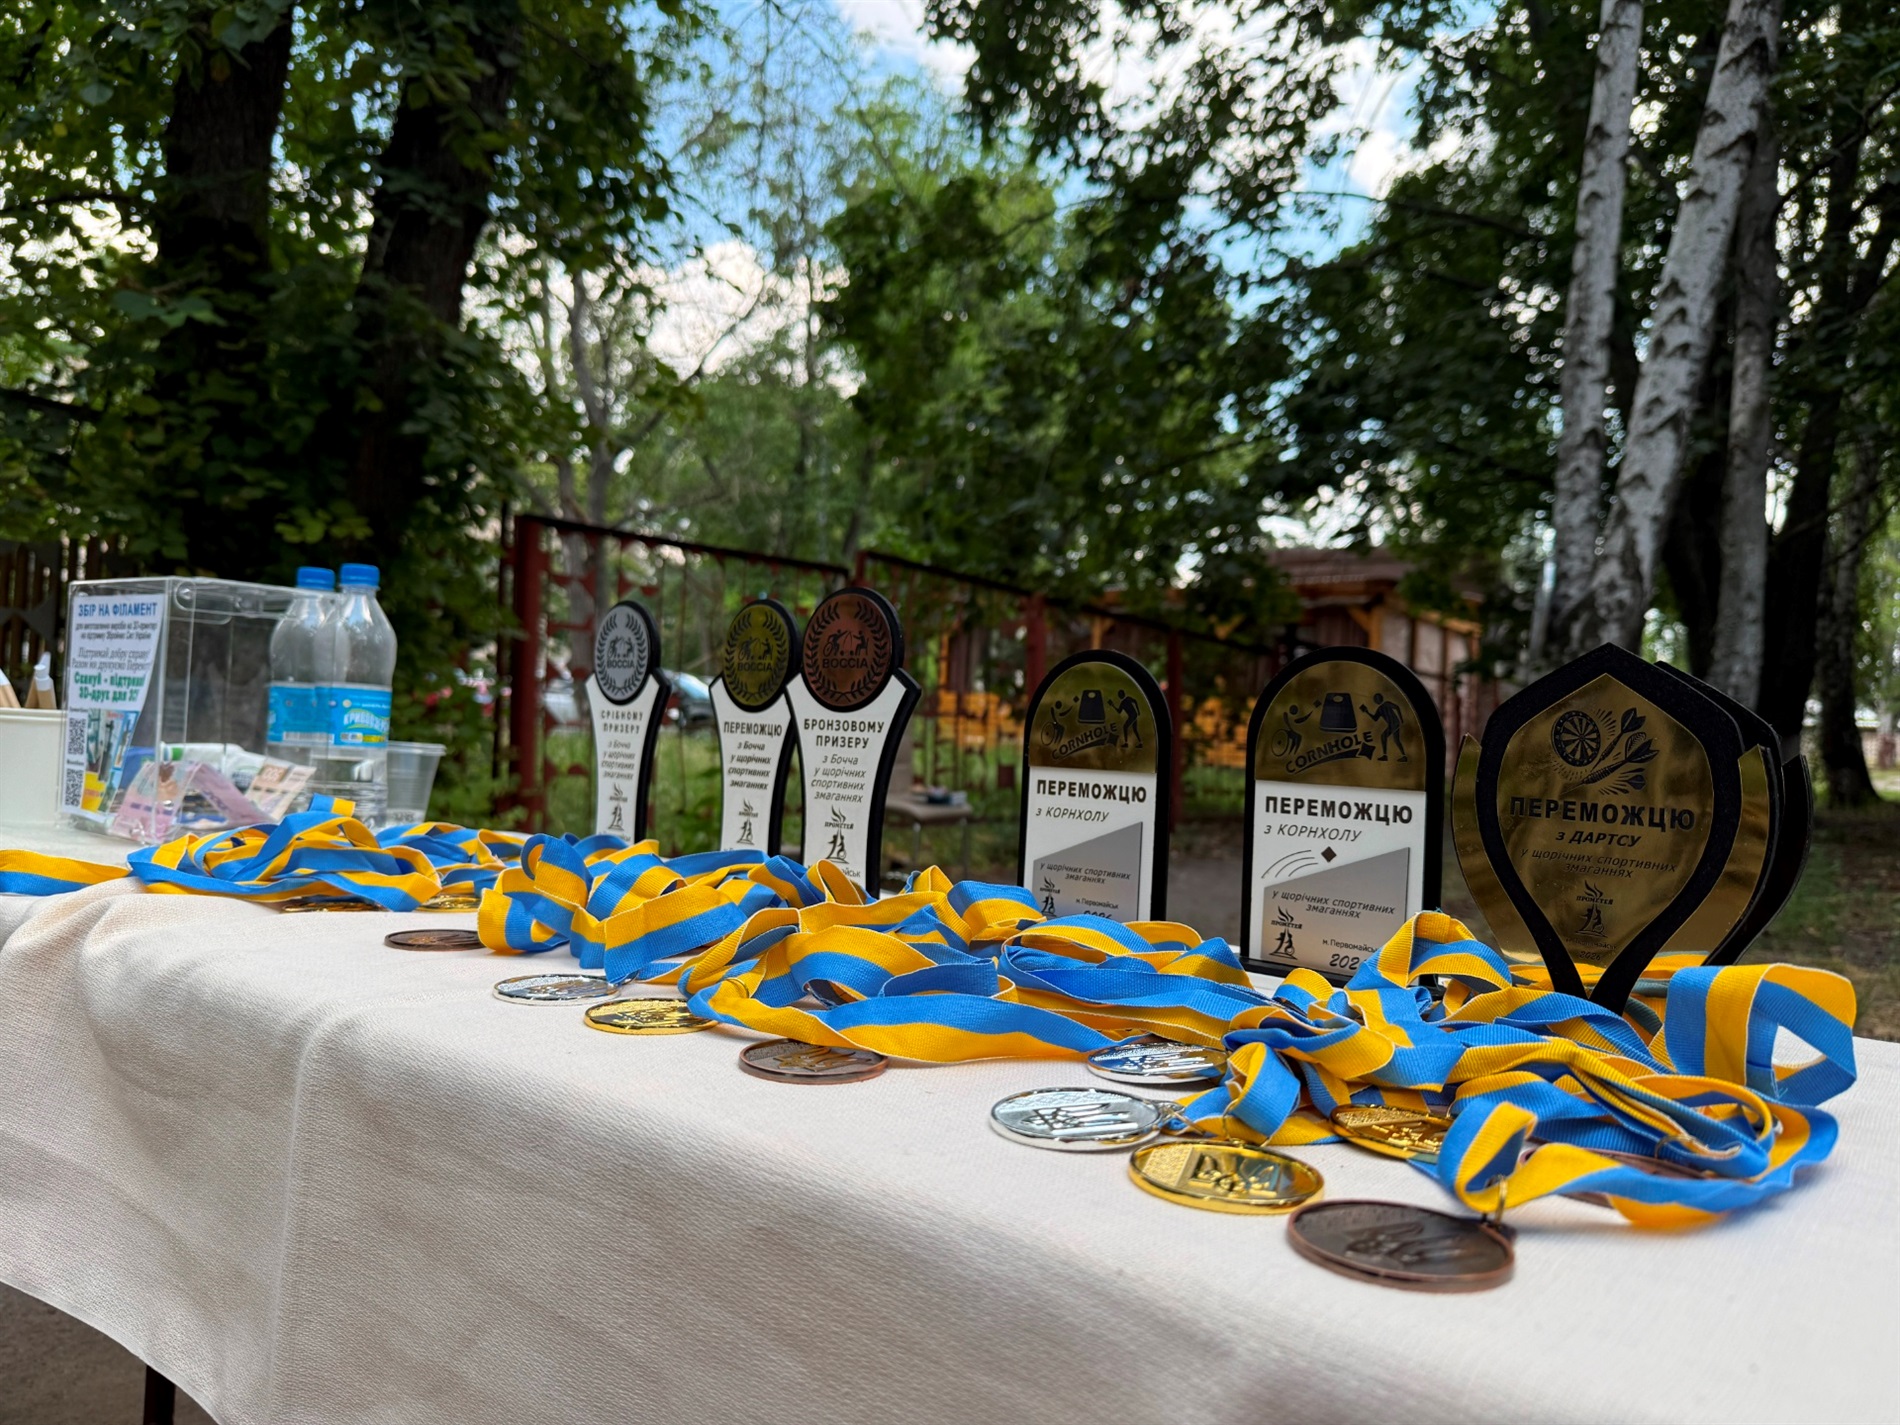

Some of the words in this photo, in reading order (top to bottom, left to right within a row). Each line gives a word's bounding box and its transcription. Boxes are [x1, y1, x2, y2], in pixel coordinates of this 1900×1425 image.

[78, 604, 96, 617] ЗБІР
[98, 603, 110, 616] НА
[112, 602, 158, 616] ФІЛАМЕНТ
[606, 660, 634, 668] BOCCIA
[738, 662, 773, 672] BOCCIA
[822, 658, 868, 669] BOCCIA
[601, 710, 643, 721] СРІБНОМУ
[603, 722, 640, 734] ПРИЗЕРУ
[723, 721, 783, 738] ПЕРЕМОЖЦЮ
[804, 718, 885, 733] БРОНЗОВОМУ
[743, 741, 766, 751] Бочча
[816, 735, 869, 749] ПРИЗЕРУ
[1052, 722, 1118, 760] CORNHOLE
[736, 754, 772, 764] щорічних
[822, 755, 828, 763] з
[830, 754, 859, 765] Бочча
[1285, 730, 1374, 774] CORNHOLE
[728, 766, 771, 778] спортивних
[814, 767, 820, 776] у
[822, 767, 866, 778] щорічних
[730, 779, 769, 790] змаганнях
[810, 778, 866, 791] спортивних
[1037, 779, 1147, 804] ПЕРЕМОЖЦЮ
[814, 791, 863, 803] змаганнях
[1036, 808, 1042, 816] з
[1046, 806, 1110, 822] КОРНХОЛУ
[1265, 796, 1413, 826] ПЕРЕМОЖЦЮ
[1510, 796, 1696, 832] ПЕРЕМОЖЦЮ
[1264, 824, 1272, 835] з
[1277, 823, 1362, 842] КОРНХОЛУ
[1555, 831, 1566, 841] з
[1568, 830, 1642, 848] ДАРТСУ
[1521, 848, 1530, 858] у
[1532, 849, 1594, 863] щорічних
[1597, 856, 1678, 872] спортивних
[1040, 862, 1046, 870] у
[1047, 863, 1083, 873] щорічних
[1084, 868, 1132, 880] спортивних
[1564, 863, 1634, 878] змаганнях
[1065, 873, 1105, 884] змаганнях
[1272, 890, 1279, 899] у
[1281, 891, 1329, 905] щорічних
[1332, 898, 1395, 915] спортивних
[1306, 904, 1362, 919] змаганнях
[1270, 919, 1303, 929] ПРОМЕТЕЙ
[1322, 938, 1330, 946] м.
[1331, 939, 1378, 953] Первомайсь
[1330, 953, 1367, 970] 202
